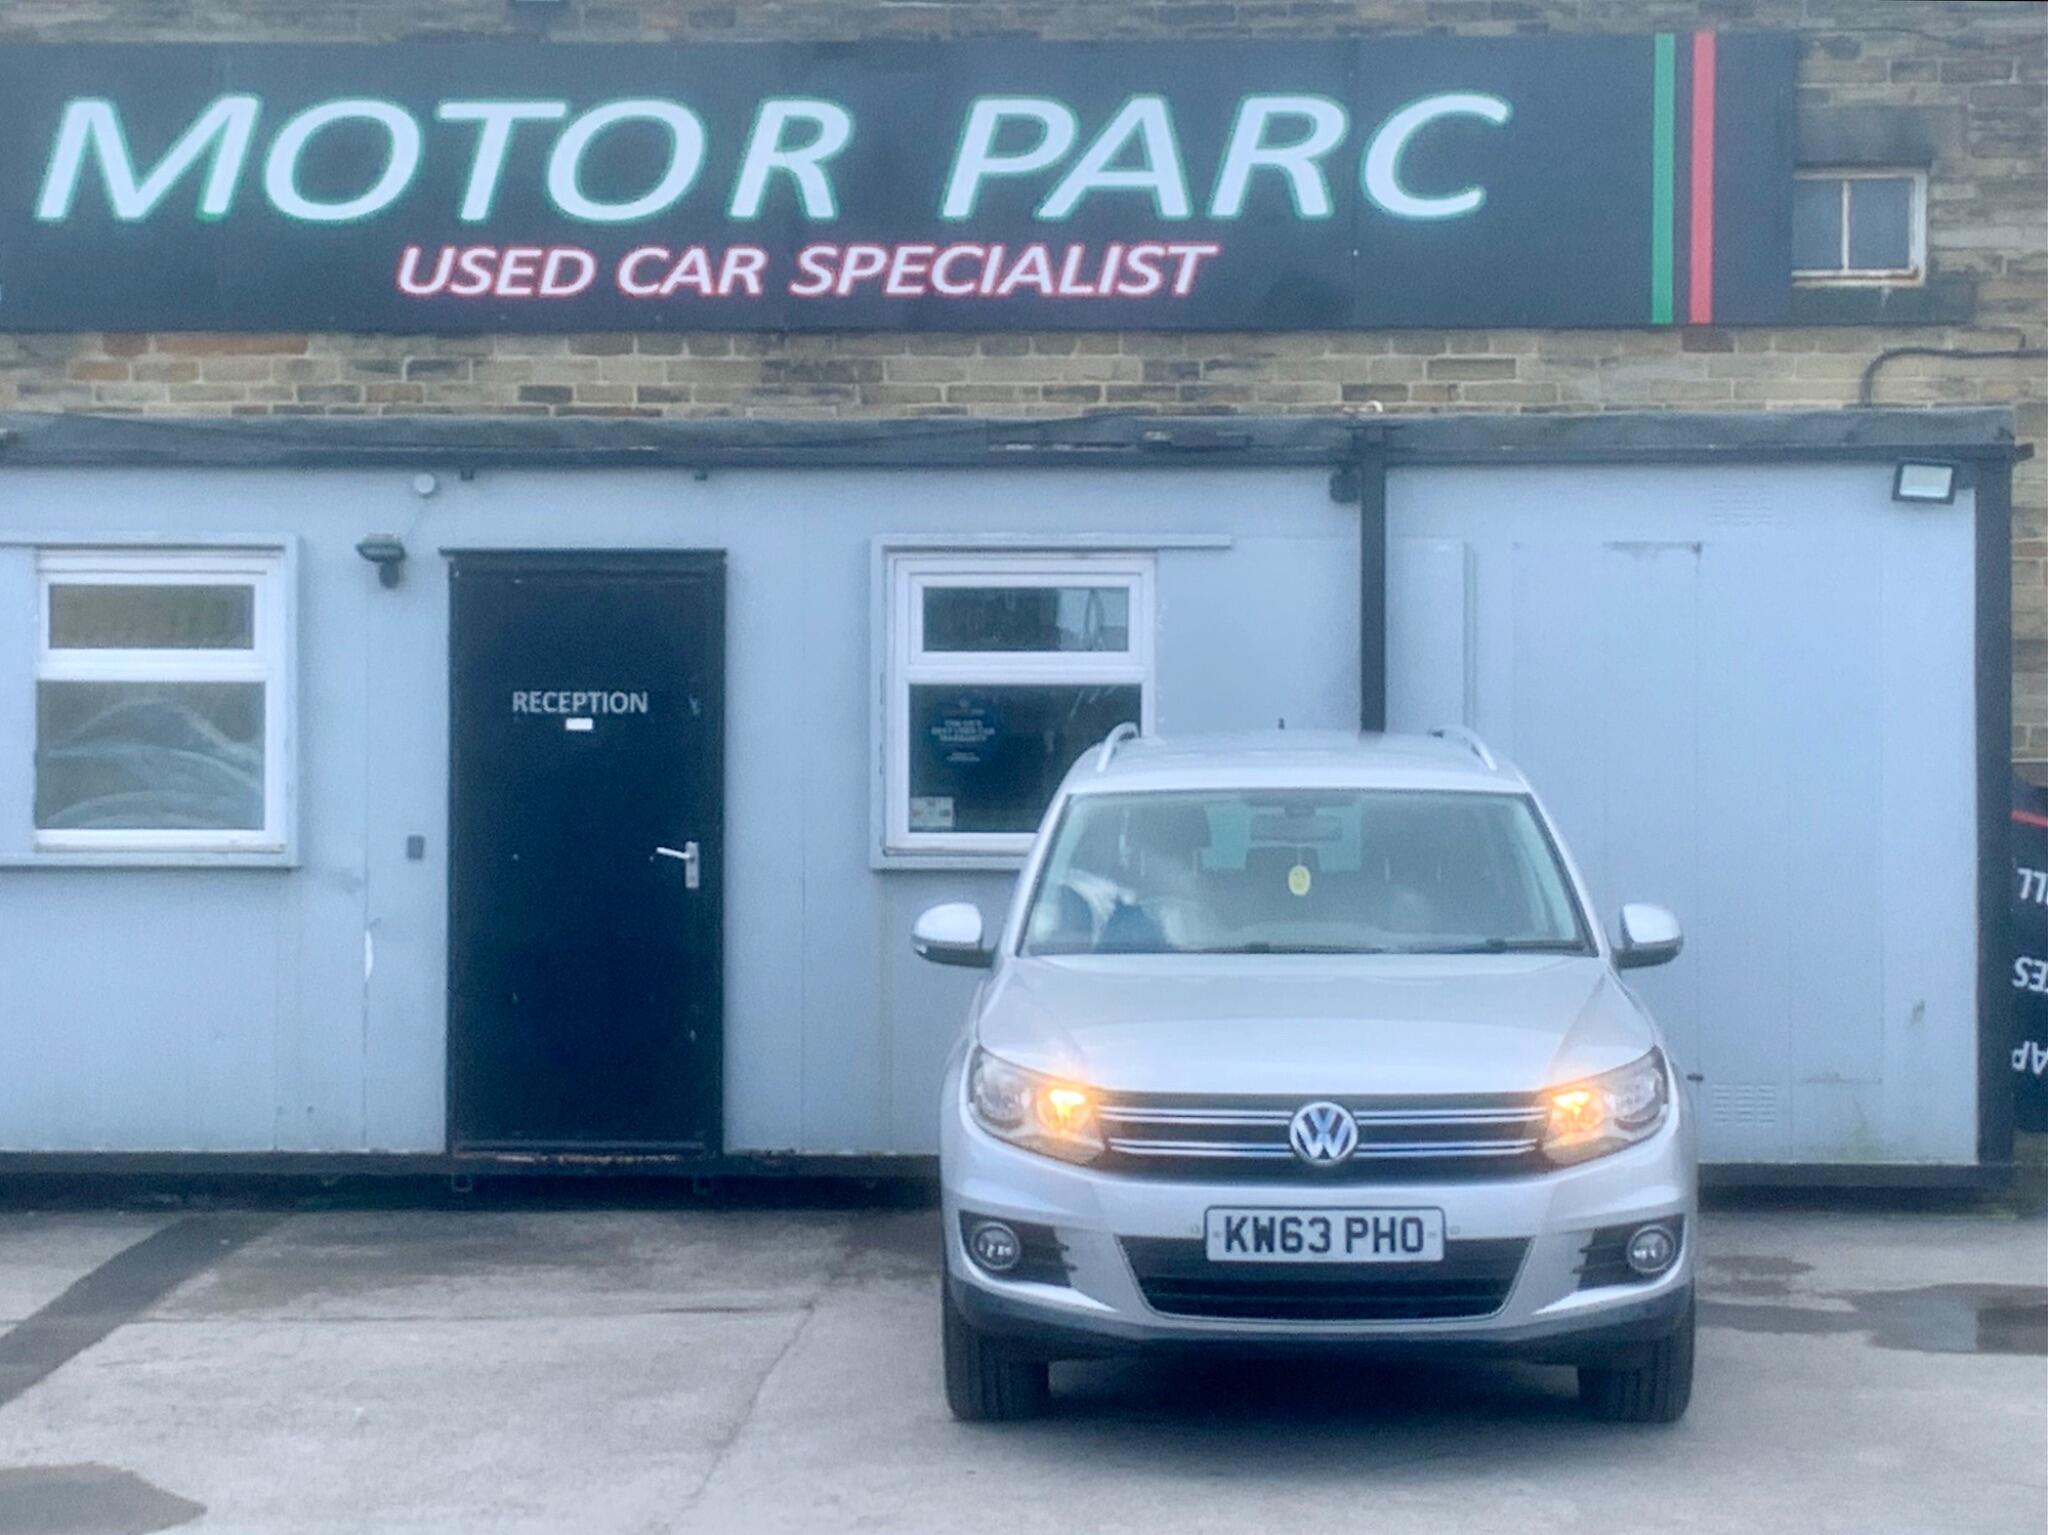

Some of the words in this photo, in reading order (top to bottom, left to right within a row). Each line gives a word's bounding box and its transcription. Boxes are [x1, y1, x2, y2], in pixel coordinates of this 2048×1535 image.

[36, 93, 852, 221] MOTOR
[942, 93, 1511, 218] PARC
[397, 245, 598, 297] USED
[616, 245, 769, 296] CAR
[789, 241, 1221, 297] SPECIALIST
[511, 690, 648, 715] RECEPTION
[1292, 1104, 1356, 1162] VW
[1225, 1216, 1331, 1254] KW63
[1345, 1217, 1424, 1254] PHO
